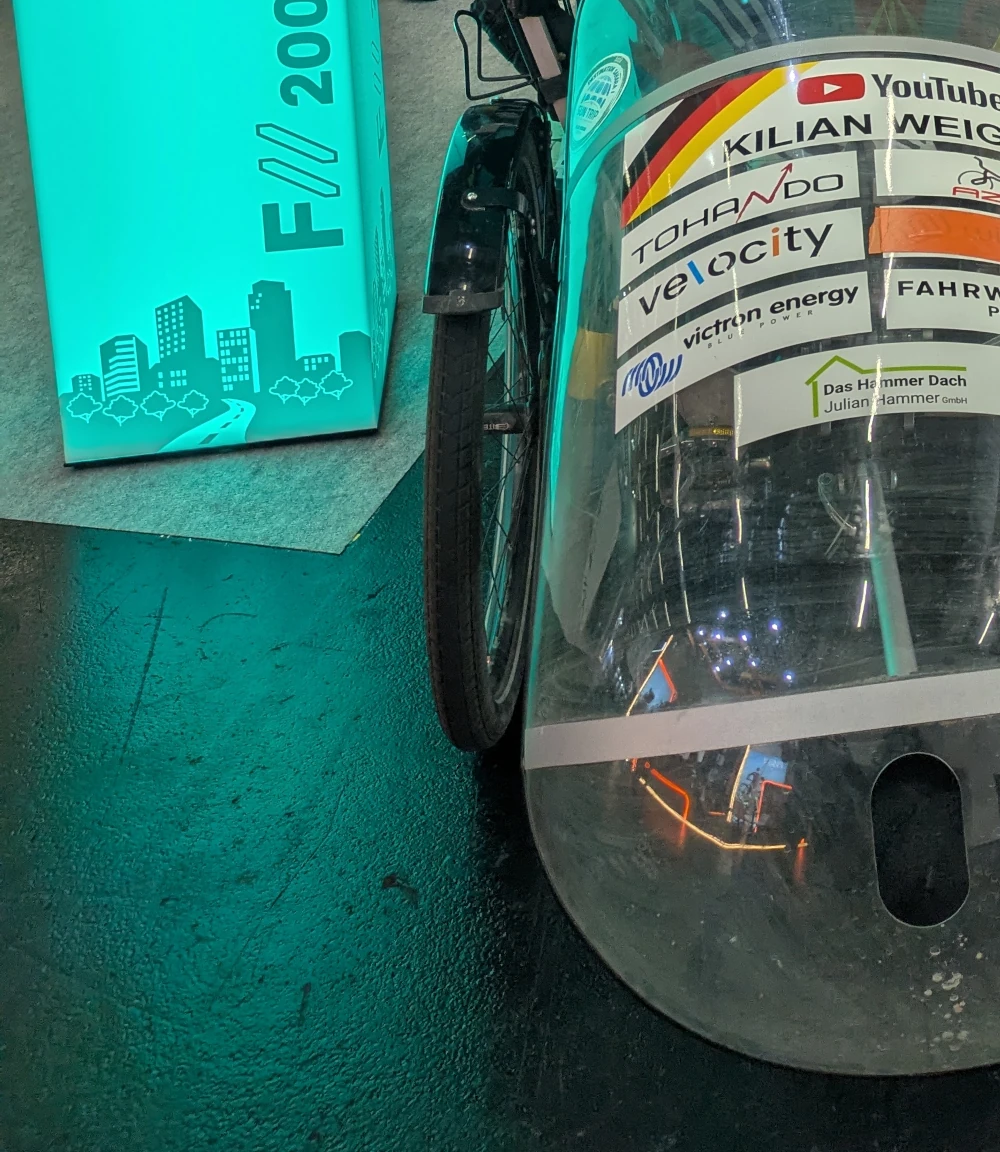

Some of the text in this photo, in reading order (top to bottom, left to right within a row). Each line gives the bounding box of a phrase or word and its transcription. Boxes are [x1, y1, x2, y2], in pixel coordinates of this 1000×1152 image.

[723, 113, 872, 163] KILIAN
[638, 223, 834, 316] velocity
[683, 285, 859, 350] victron energy
[823, 374, 967, 396] Das Hammer Dach
[824, 393, 968, 413] Julian Hammer GmbH
